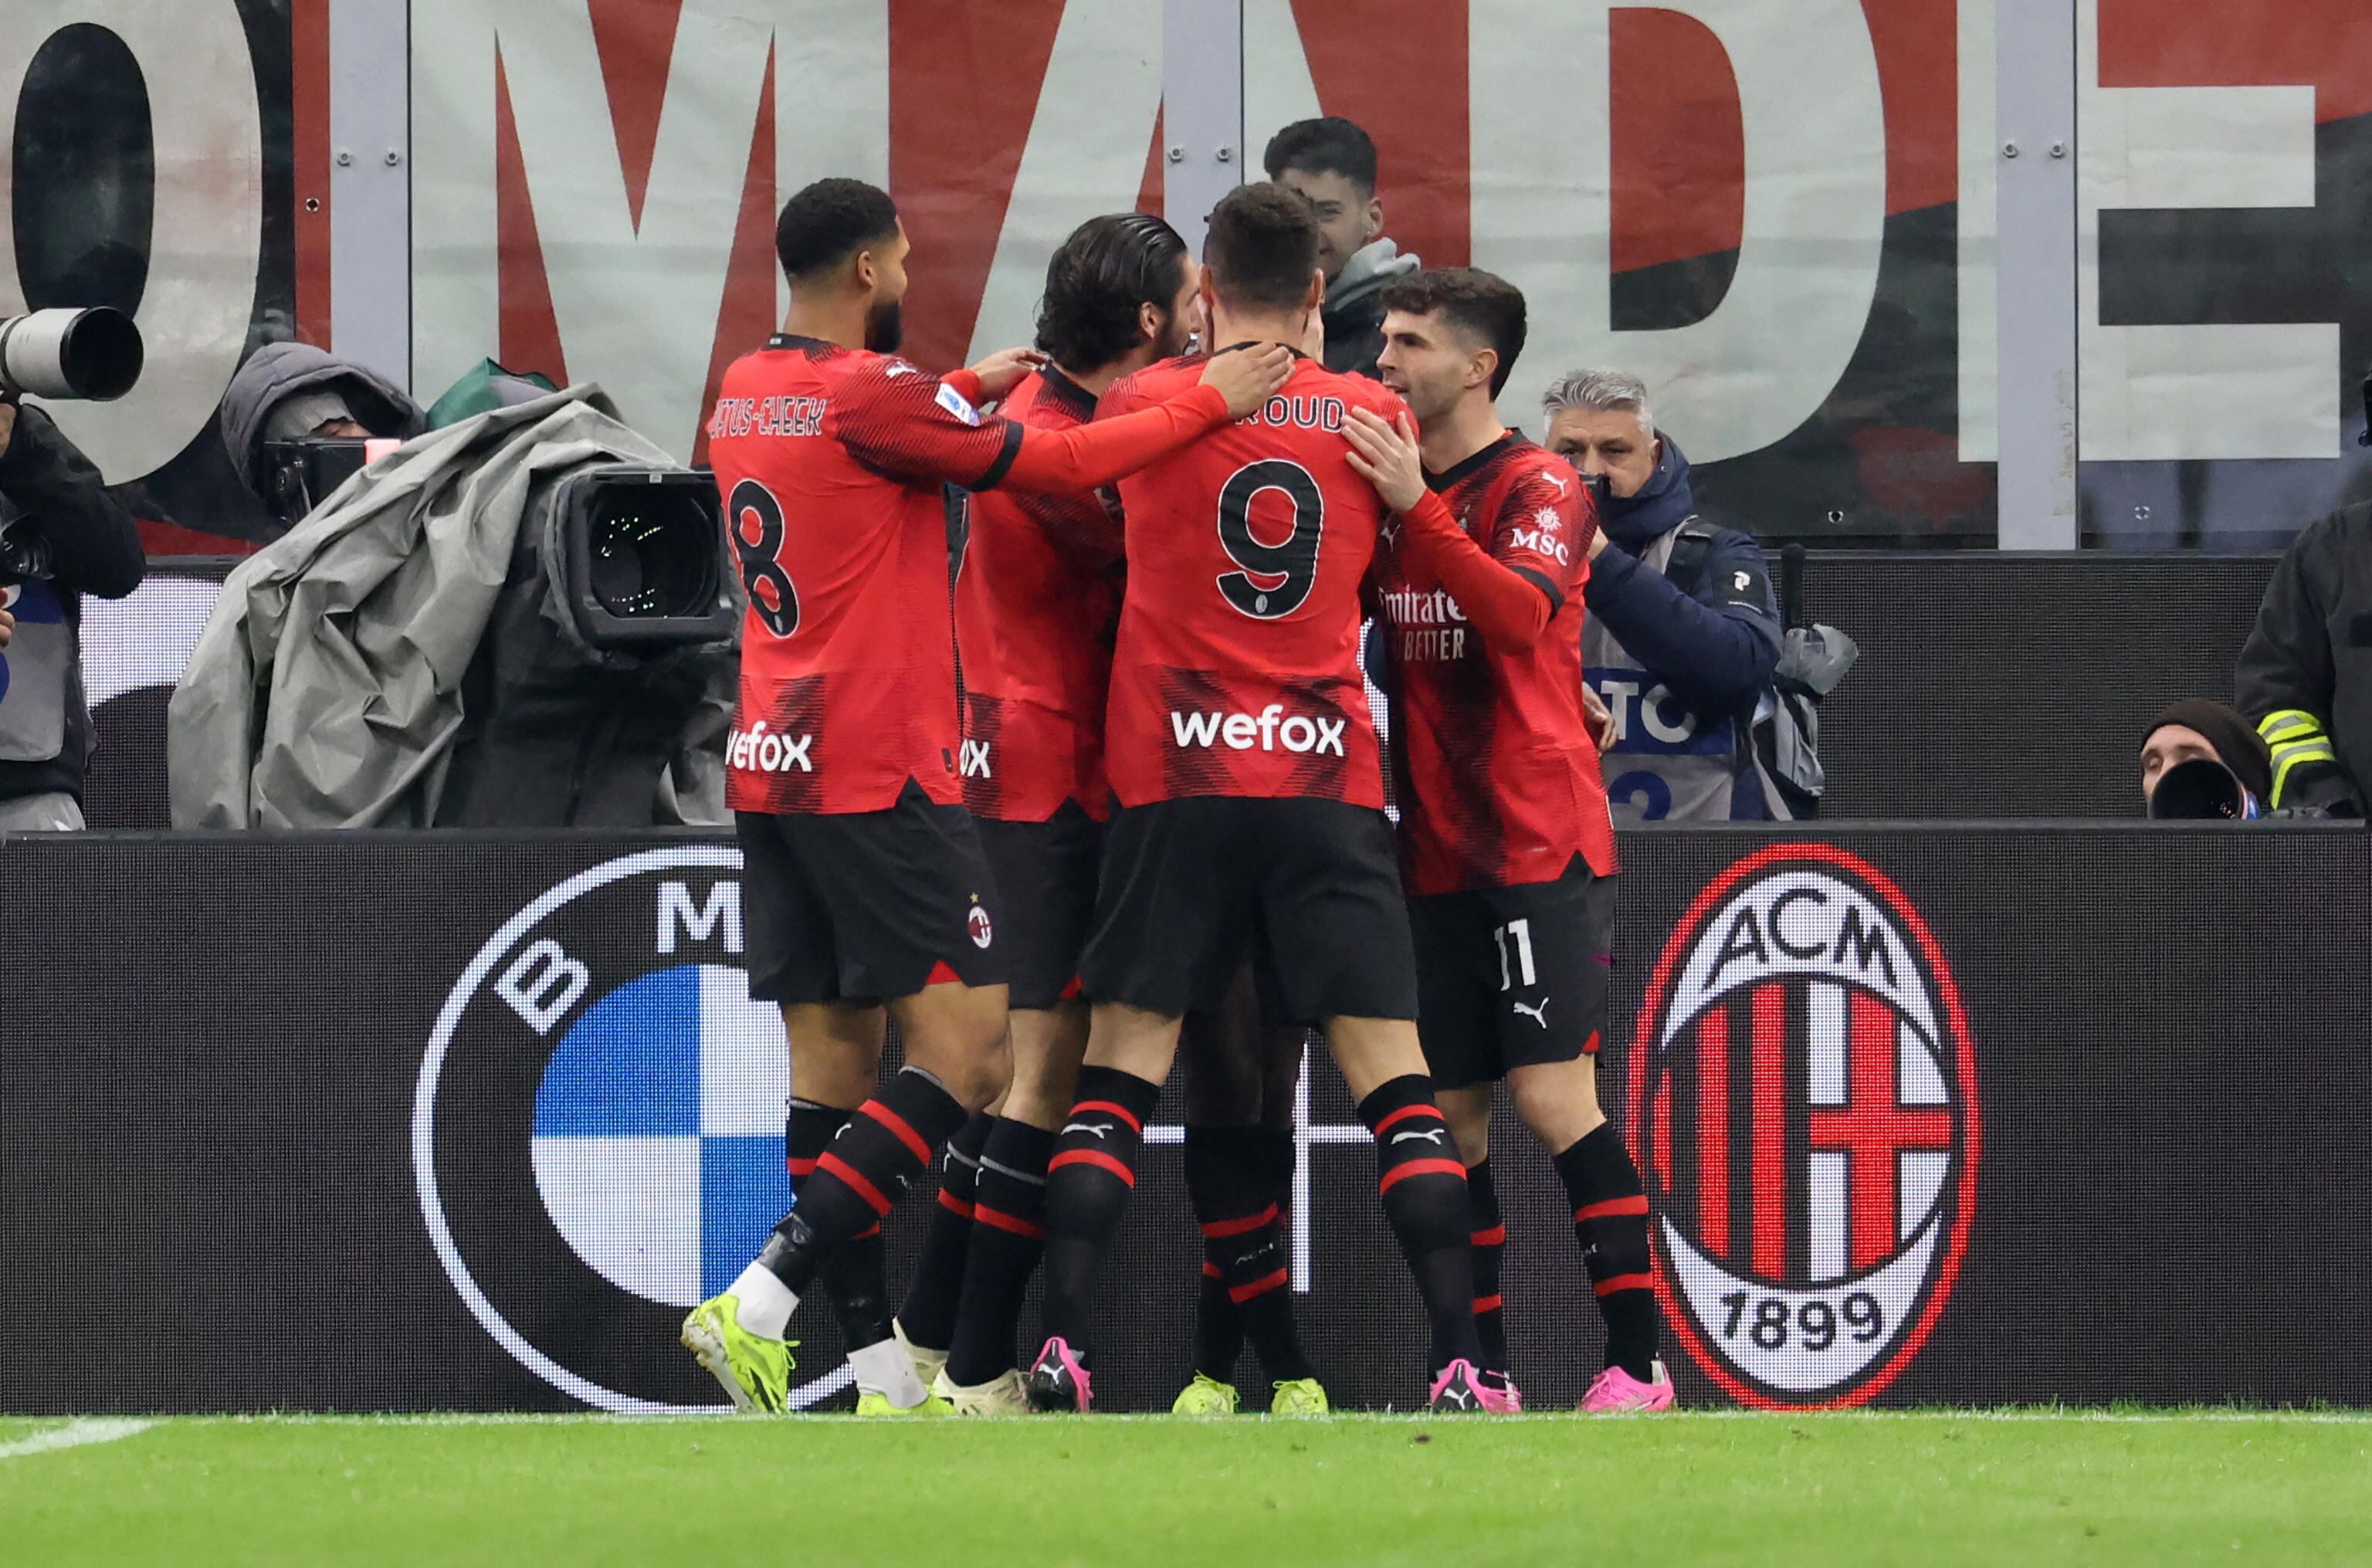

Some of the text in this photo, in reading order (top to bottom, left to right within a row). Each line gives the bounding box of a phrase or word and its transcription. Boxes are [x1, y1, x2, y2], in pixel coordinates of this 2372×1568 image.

[411, 0, 2340, 465] MADE
[728, 479, 800, 638] 8
[1216, 459, 1324, 619] 9
[1510, 528, 1569, 566] MSC
[1404, 628, 1464, 661] BETTER
[1171, 703, 1345, 757] wefox
[494, 880, 744, 1036] BM
[1494, 918, 1536, 991] 11
[1703, 887, 1899, 994] ACM
[1720, 1290, 1882, 1351] 1899
